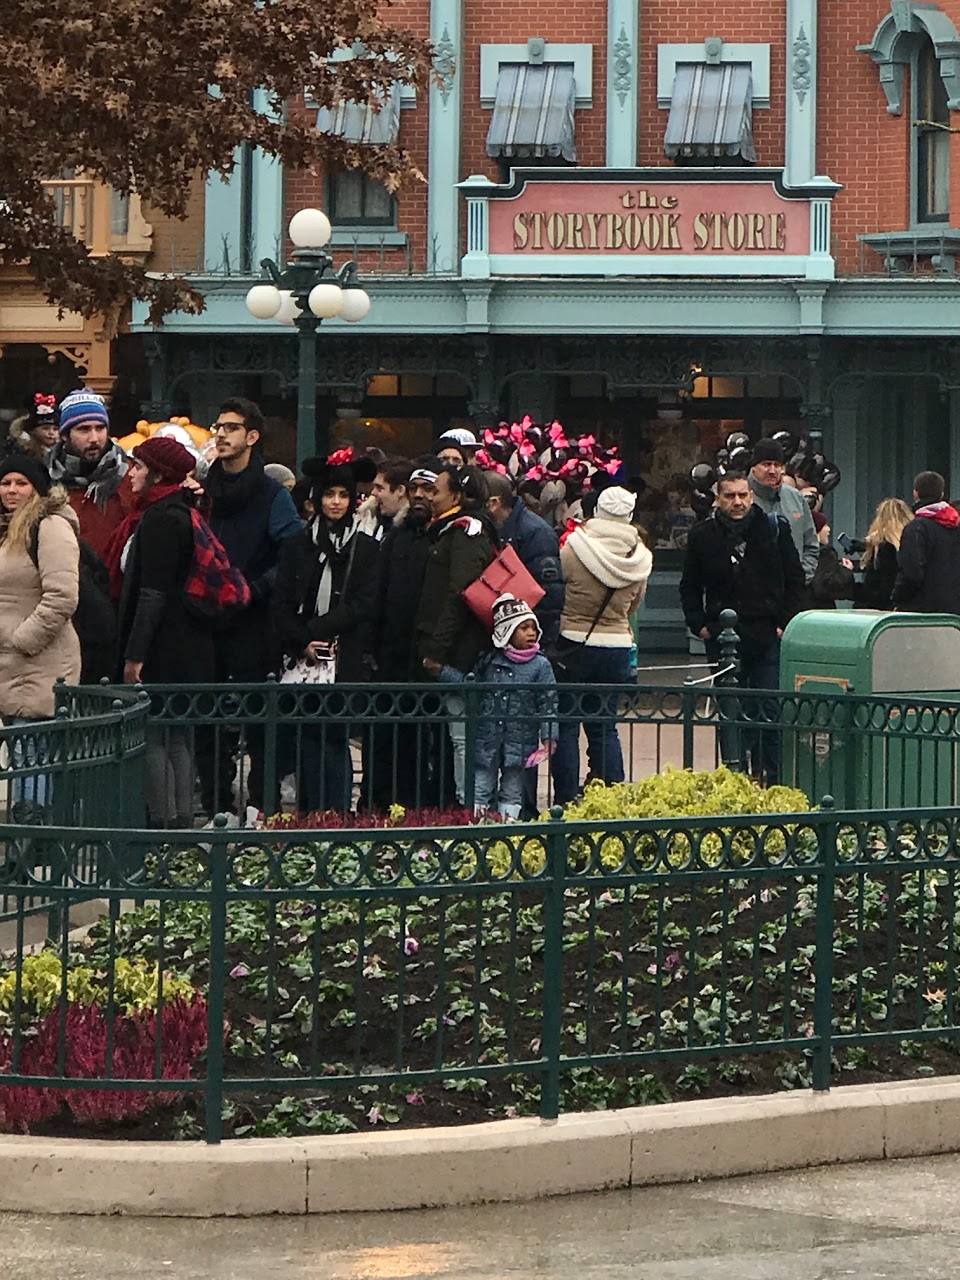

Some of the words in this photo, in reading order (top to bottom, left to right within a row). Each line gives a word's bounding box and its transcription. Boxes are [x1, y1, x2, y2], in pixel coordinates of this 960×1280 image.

[619, 190, 678, 209] the
[512, 212, 683, 250] STORYBOOK
[693, 211, 787, 251] STORE
